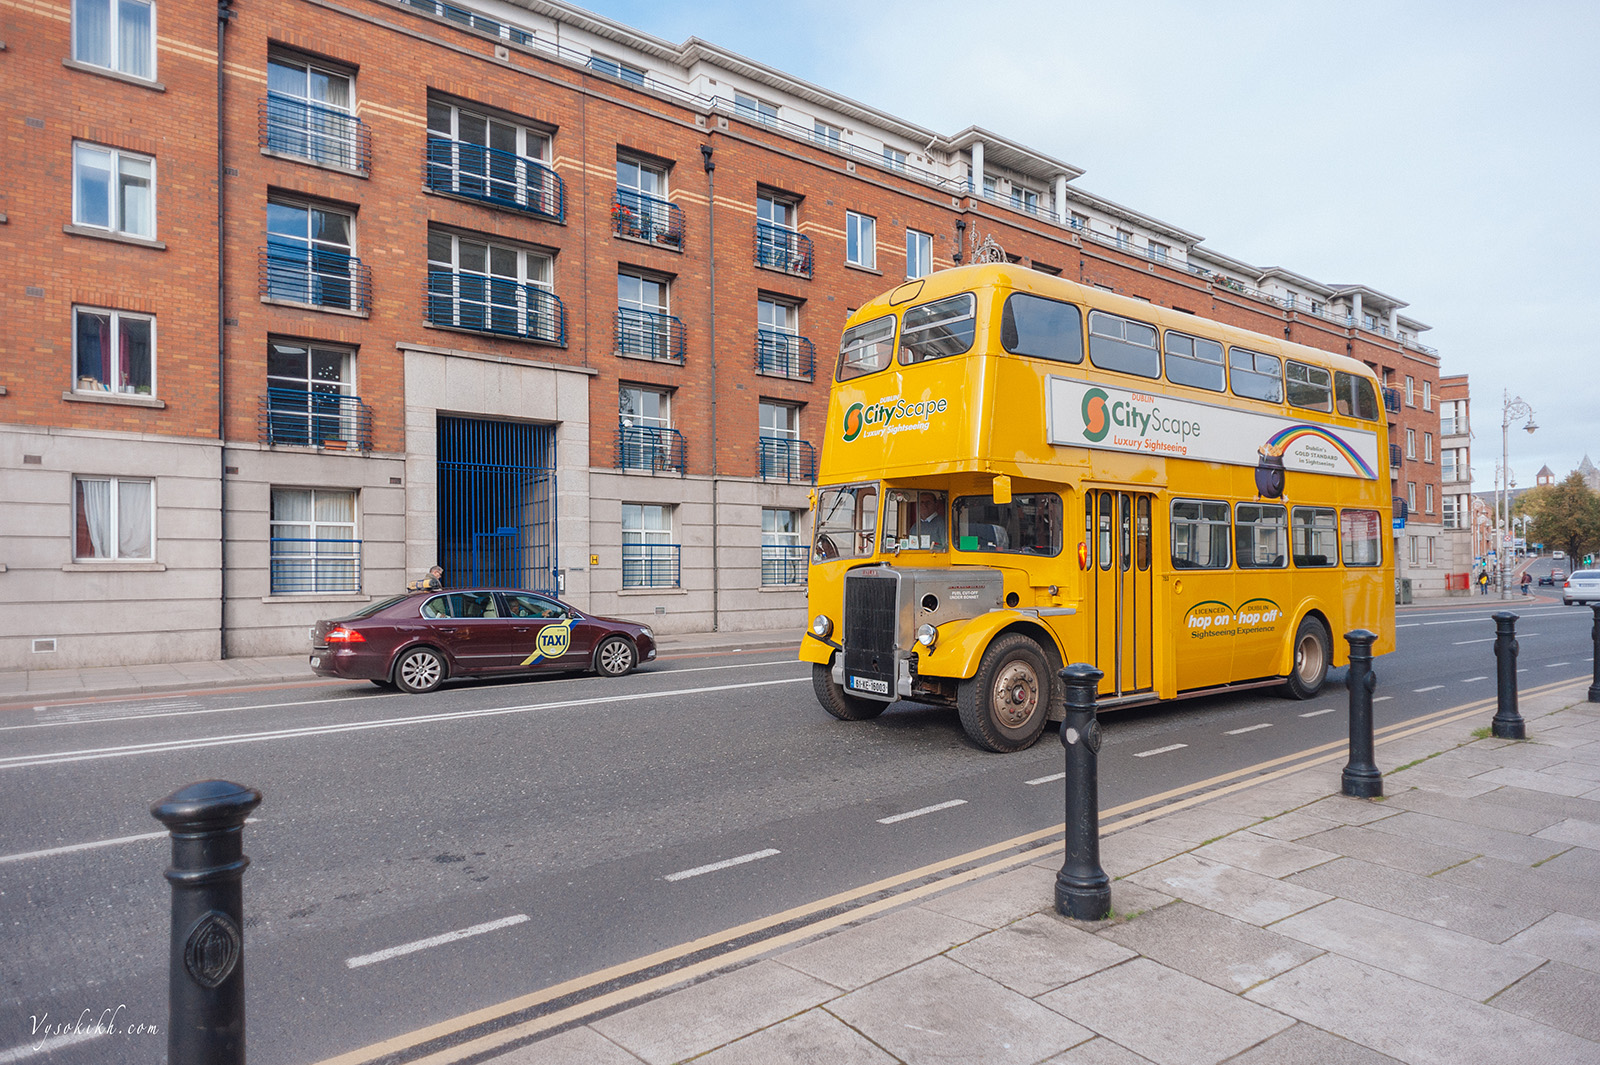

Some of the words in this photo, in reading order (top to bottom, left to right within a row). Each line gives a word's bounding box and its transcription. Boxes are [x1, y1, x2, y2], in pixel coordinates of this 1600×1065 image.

[880, 394, 900, 404] DUBLIN
[1132, 393, 1155, 403] DUBLIN
[864, 398, 948, 427] CityScape
[1112, 401, 1200, 442] CityScape
[863, 428, 886, 438] Luxury
[887, 421, 930, 435] Sightseeing
[1114, 435, 1143, 450] Luxury
[1144, 439, 1187, 456] Sightseeing
[1305, 445, 1327, 453] Dublin's
[1310, 452, 1339, 461] STANDARD
[1305, 459, 1335, 469] Sightseeing
[1195, 607, 1226, 615] LICENCED
[1188, 614, 1212, 630] hop
[1214, 614, 1230, 626] on
[1238, 611, 1260, 626] hop
[1262, 609, 1277, 622] off
[1191, 628, 1236, 639] Sightseeing
[1237, 625, 1275, 635] Experience
[542, 635, 566, 646] TAXI
